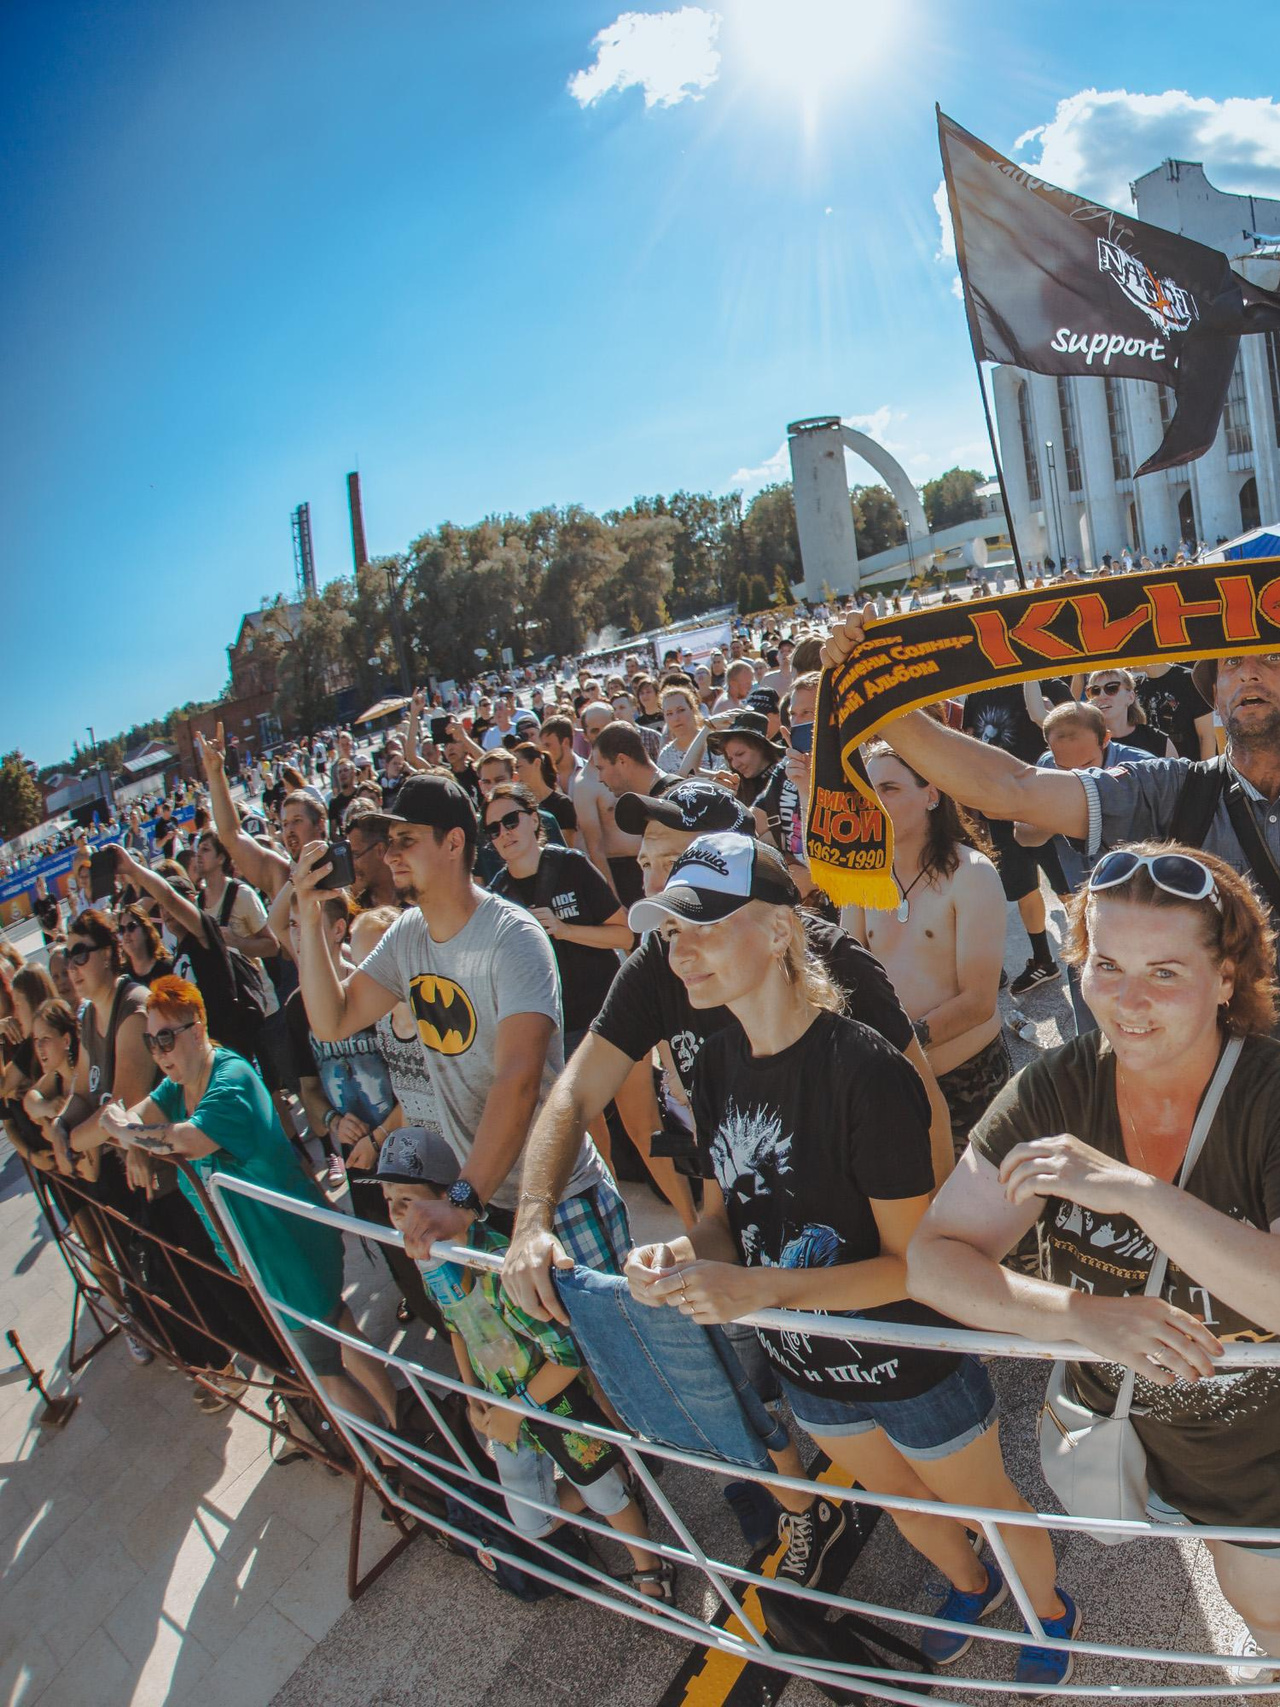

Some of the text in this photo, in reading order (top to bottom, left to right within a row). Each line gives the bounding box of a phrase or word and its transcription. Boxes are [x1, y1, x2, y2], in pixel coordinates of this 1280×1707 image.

[1051, 327, 1165, 365] support
[862, 659, 941, 700] Альбом
[808, 839, 884, 869] 1962-1990
